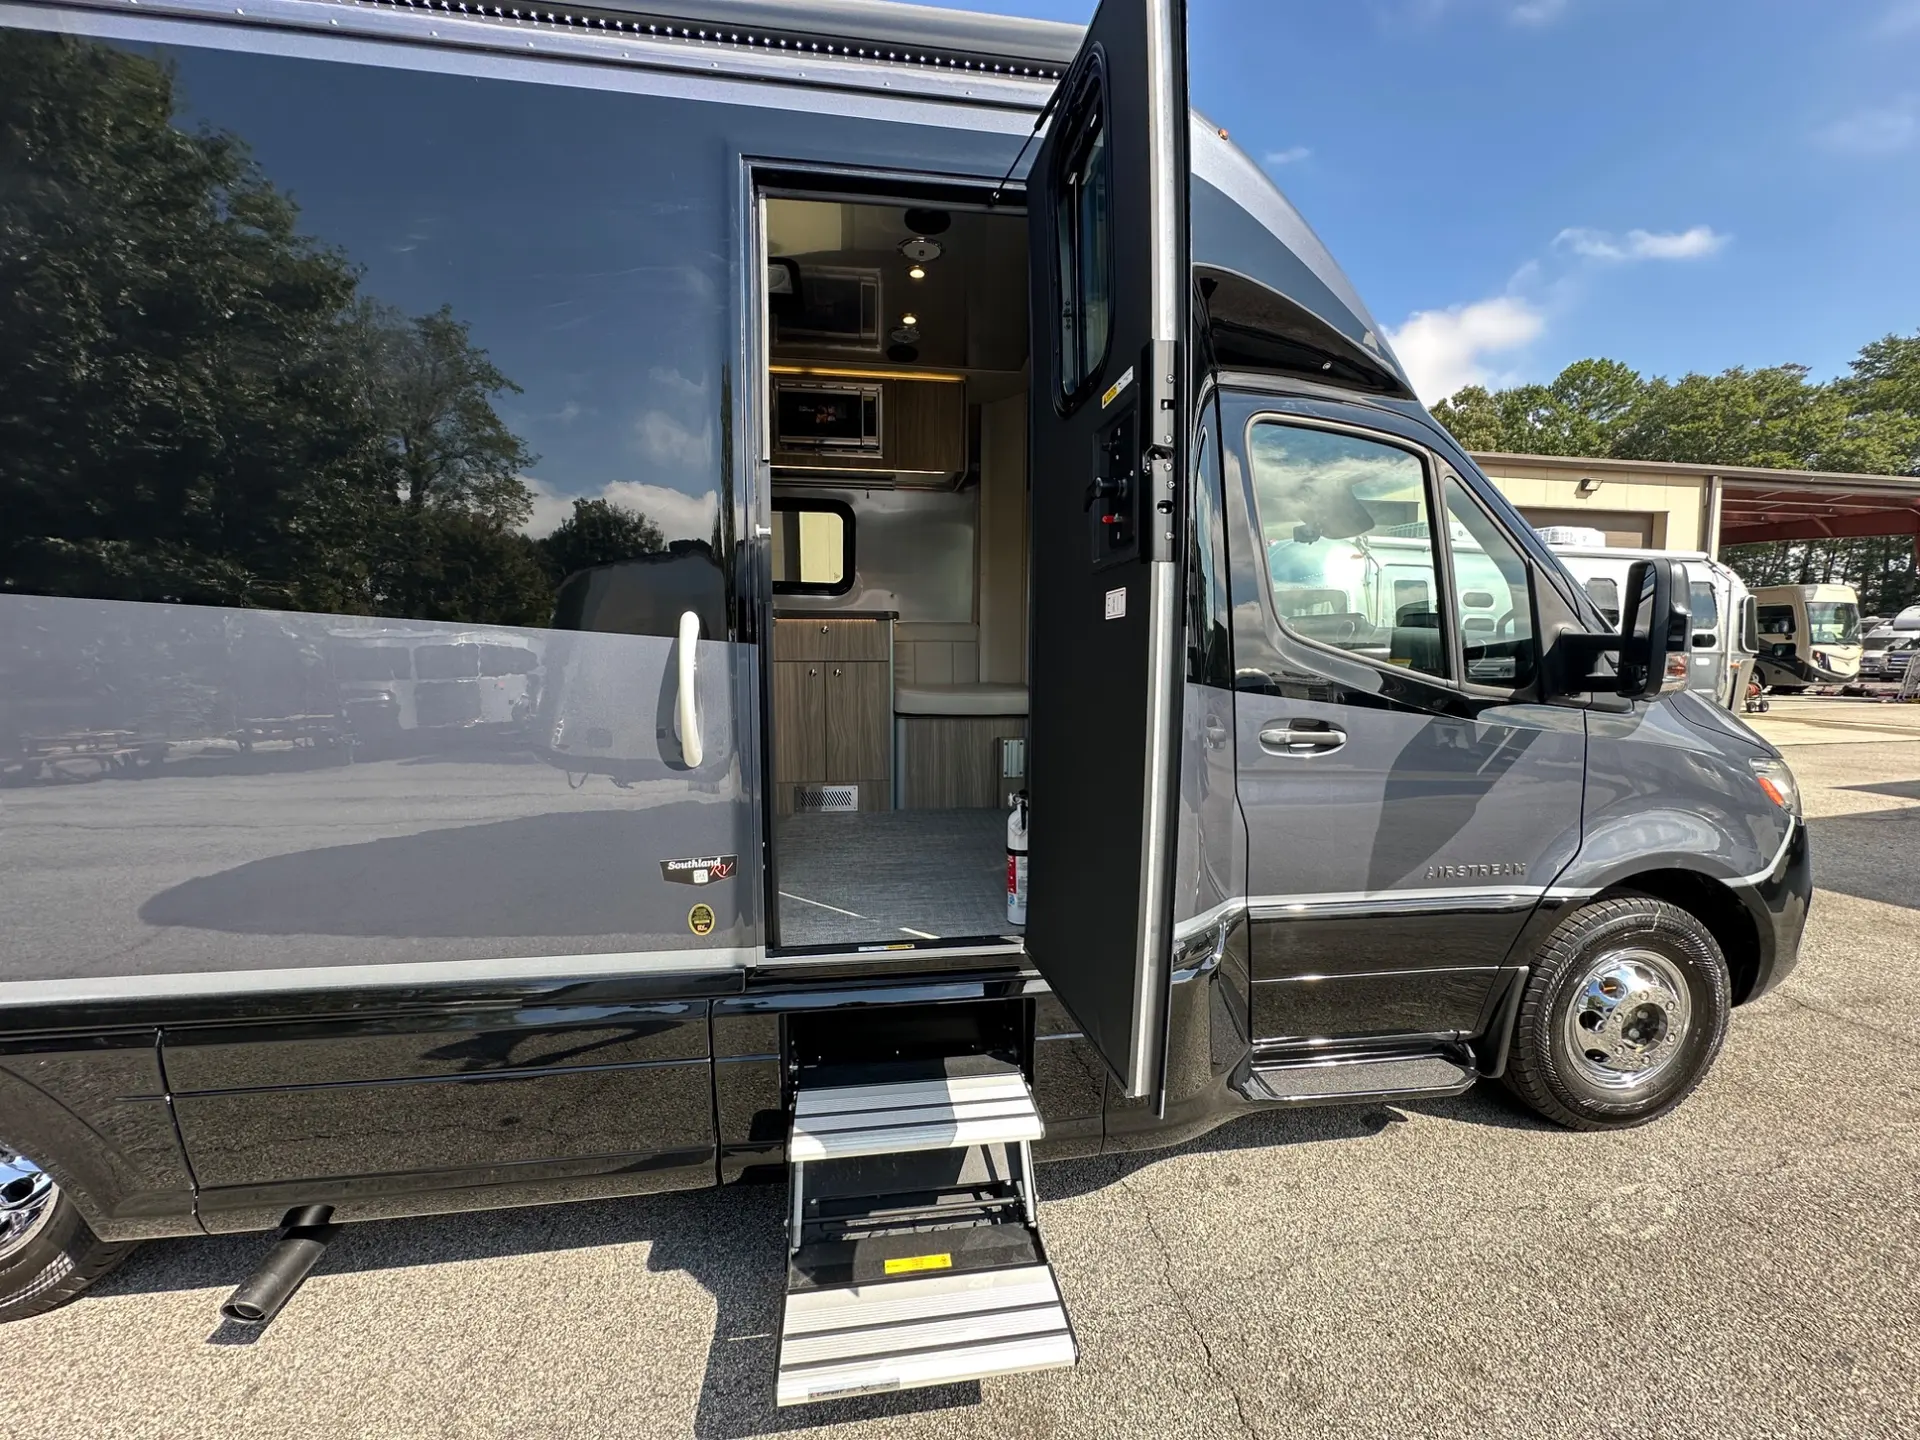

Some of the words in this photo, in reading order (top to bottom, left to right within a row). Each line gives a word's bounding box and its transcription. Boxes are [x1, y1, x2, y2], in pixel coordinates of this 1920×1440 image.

[668, 857, 721, 870] Southland
[710, 862, 733, 878] RV
[1424, 863, 1526, 880] AIRSTREAM
